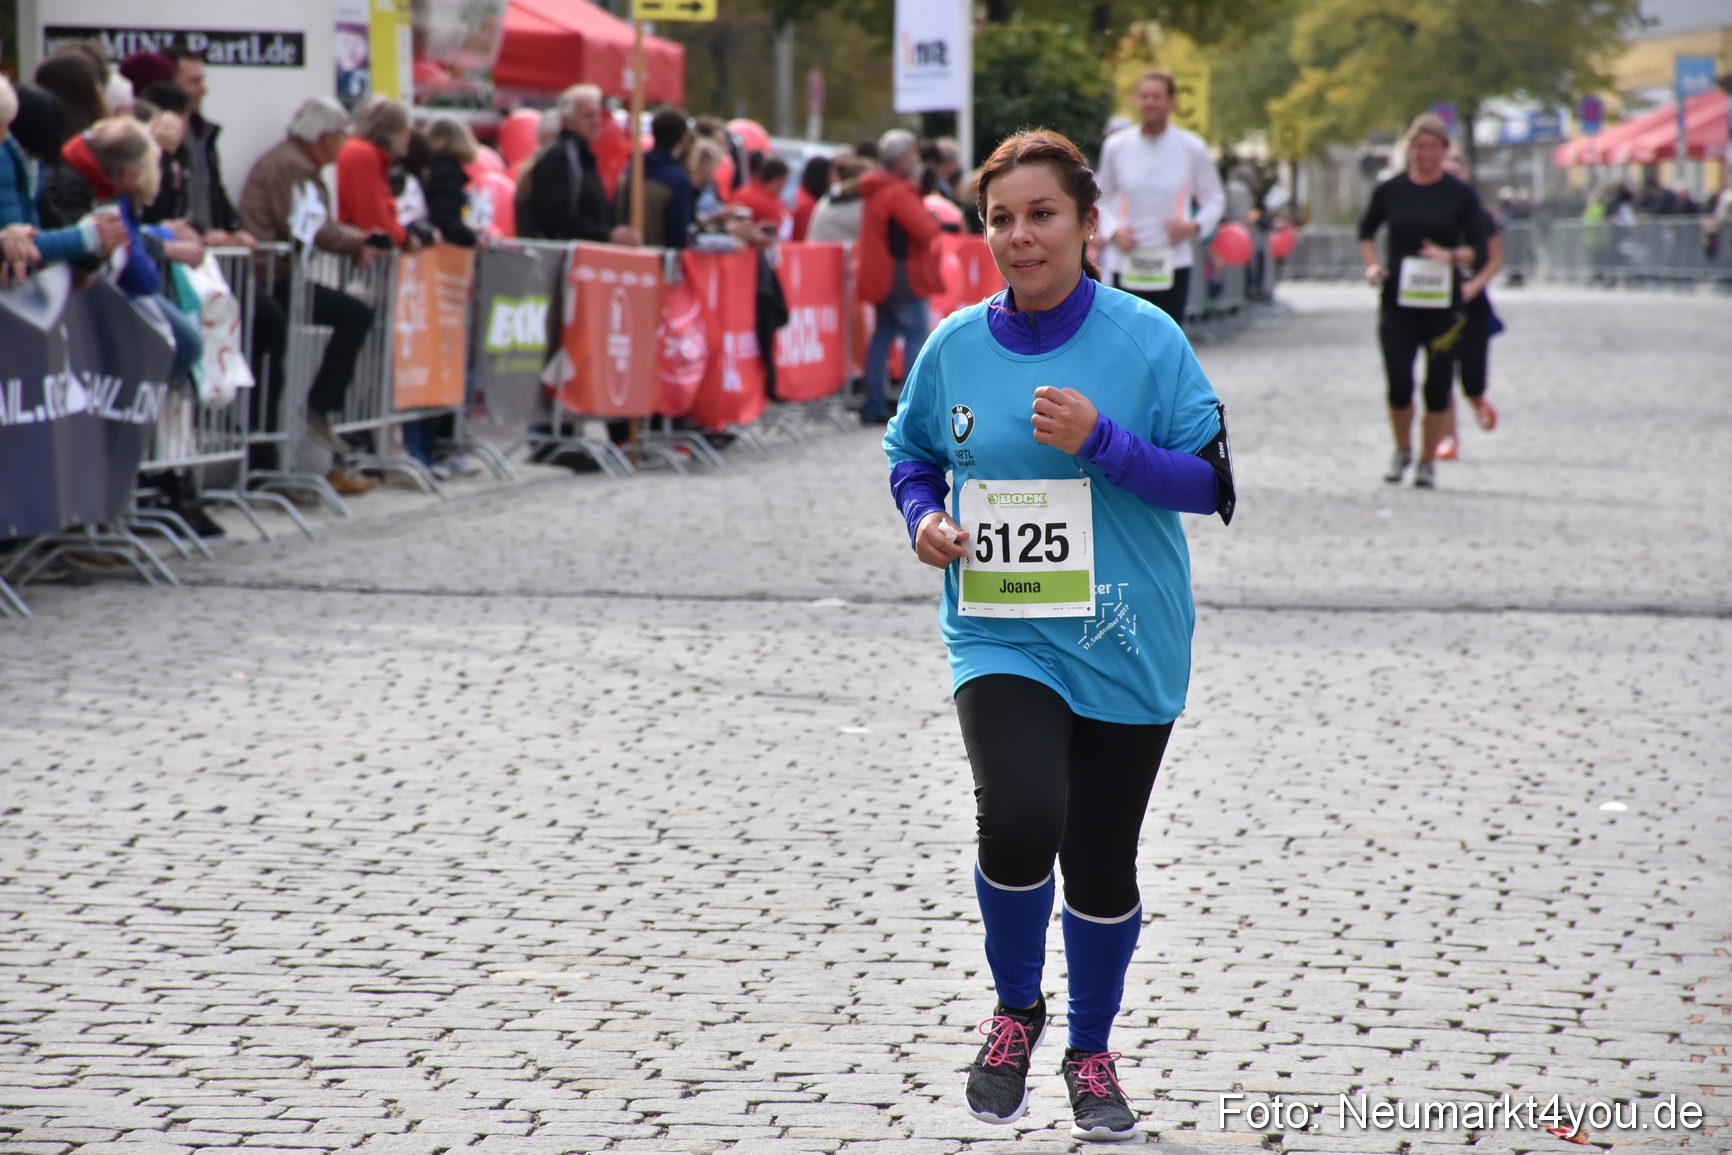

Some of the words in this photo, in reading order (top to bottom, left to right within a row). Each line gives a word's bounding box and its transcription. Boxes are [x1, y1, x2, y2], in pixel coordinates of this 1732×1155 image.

[999, 492, 1048, 504] BOCK
[975, 522, 1070, 564] 5125
[999, 579, 1041, 594] Joana
[1090, 617, 1120, 644] September
[1116, 604, 1130, 620] 2017
